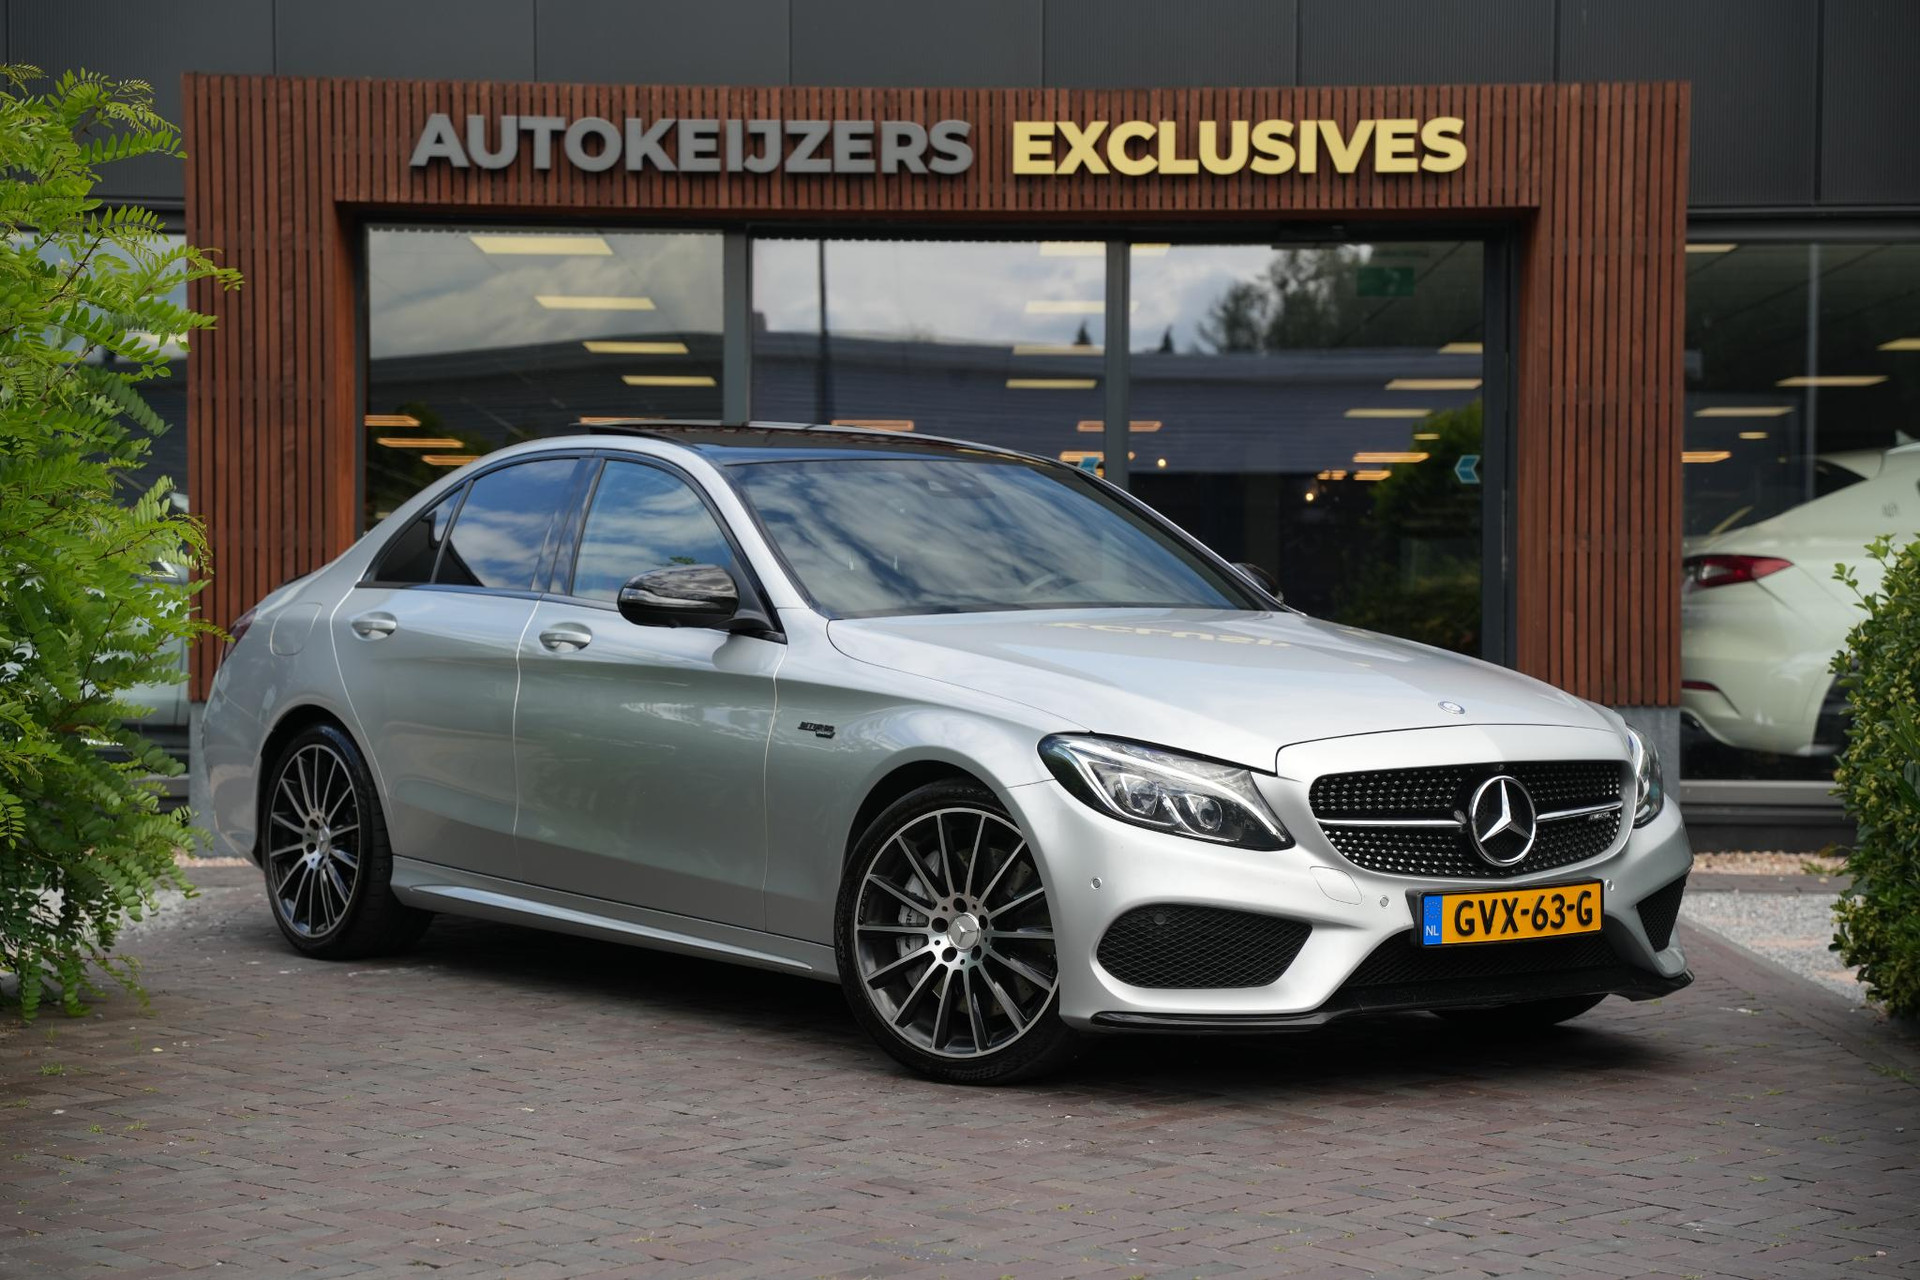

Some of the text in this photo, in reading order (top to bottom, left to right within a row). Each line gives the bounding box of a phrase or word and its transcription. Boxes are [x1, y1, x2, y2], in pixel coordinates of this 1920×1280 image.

[409, 113, 1468, 175] AUTOKEIJZERS EXCLUSIVES
[1425, 924, 1440, 937] NL
[1454, 890, 1593, 936] GVX-63-G
